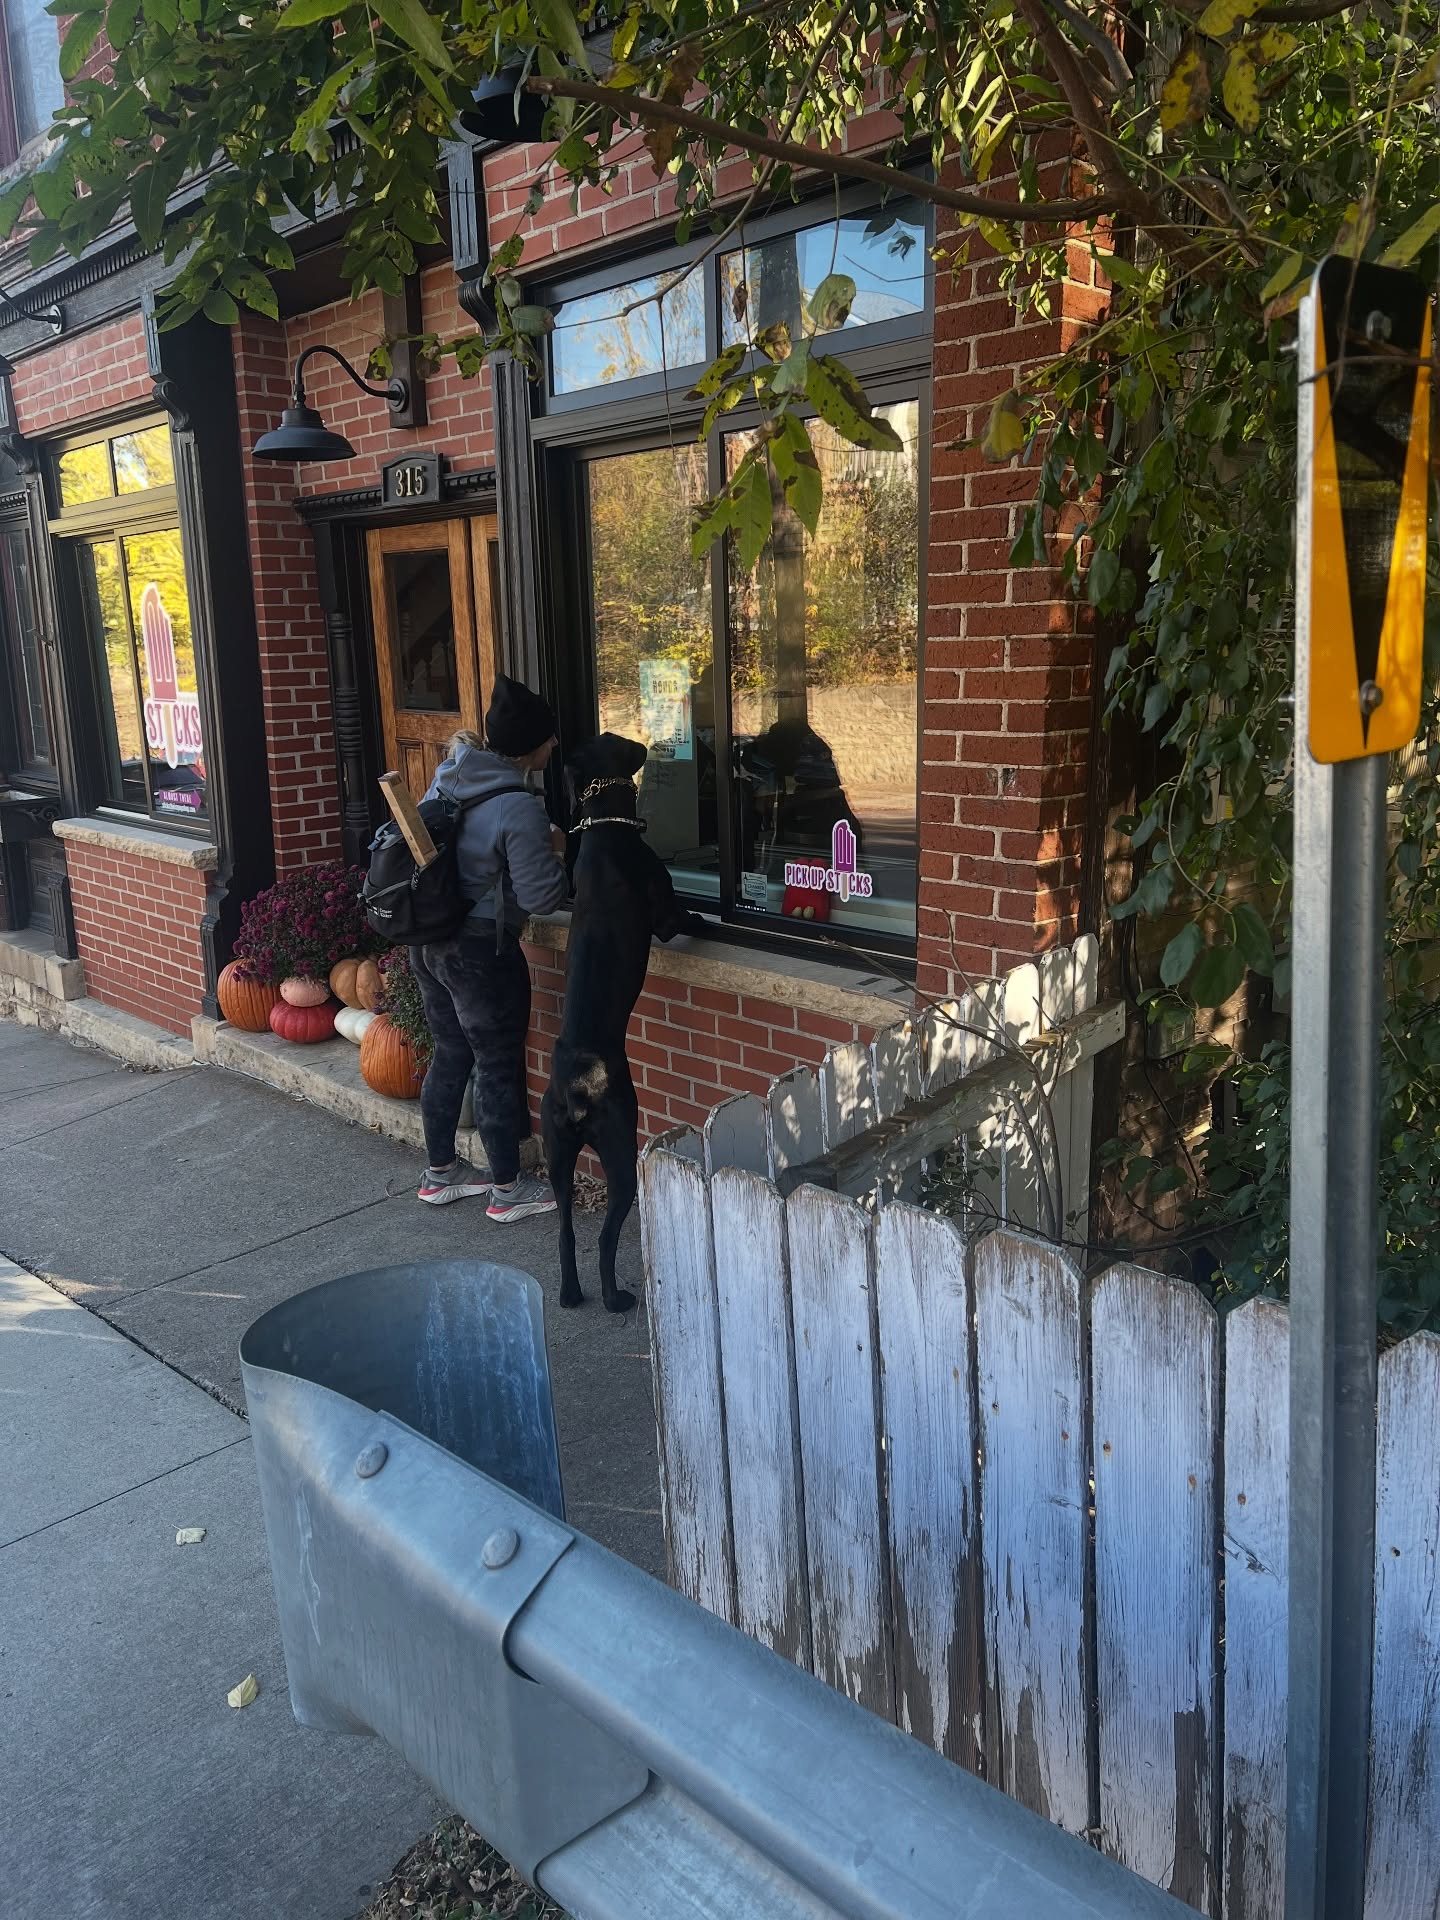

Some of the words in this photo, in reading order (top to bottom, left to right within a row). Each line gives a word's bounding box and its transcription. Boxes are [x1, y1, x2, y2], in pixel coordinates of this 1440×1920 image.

[395, 466, 423, 497] 315
[147, 703, 201, 747] STICKS
[786, 865, 808, 887] PICK
[811, 867, 824, 888] UP
[827, 871, 871, 896] STICKS
